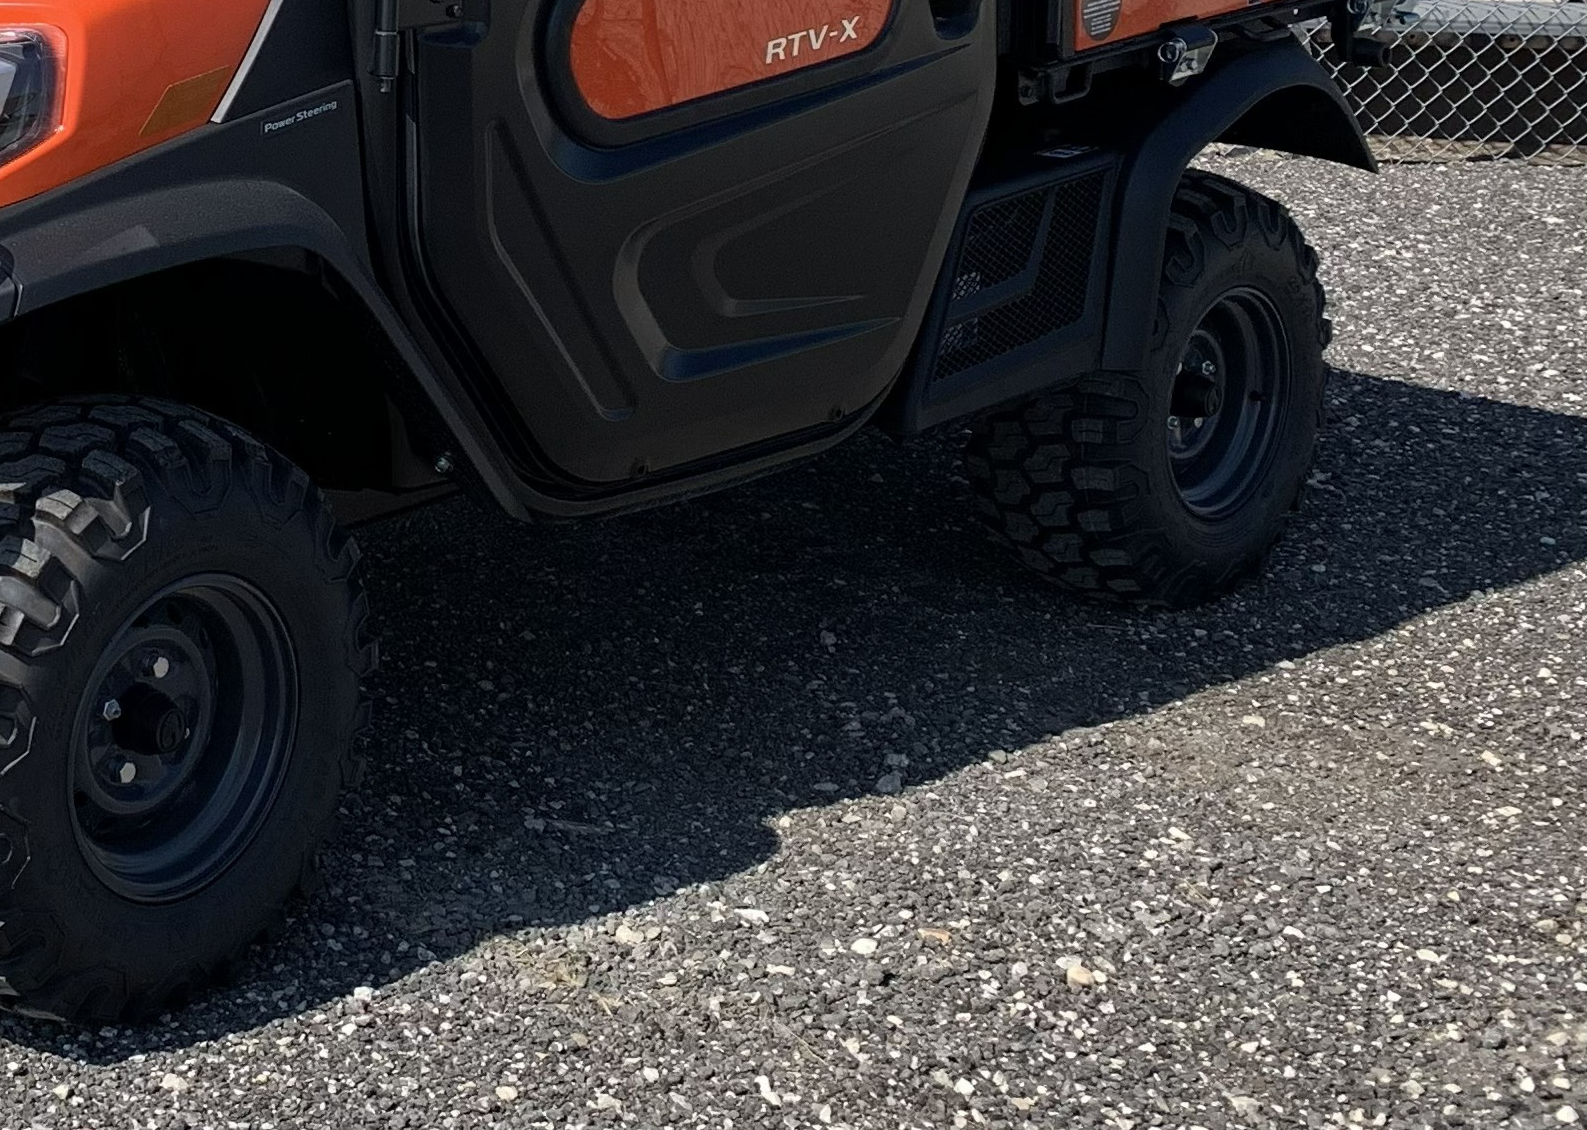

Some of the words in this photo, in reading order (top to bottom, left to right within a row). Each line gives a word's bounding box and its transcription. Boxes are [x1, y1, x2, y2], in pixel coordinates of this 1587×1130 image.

[765, 15, 860, 65] RTV-X
[264, 115, 295, 133] Power
[296, 101, 338, 122] Steering
